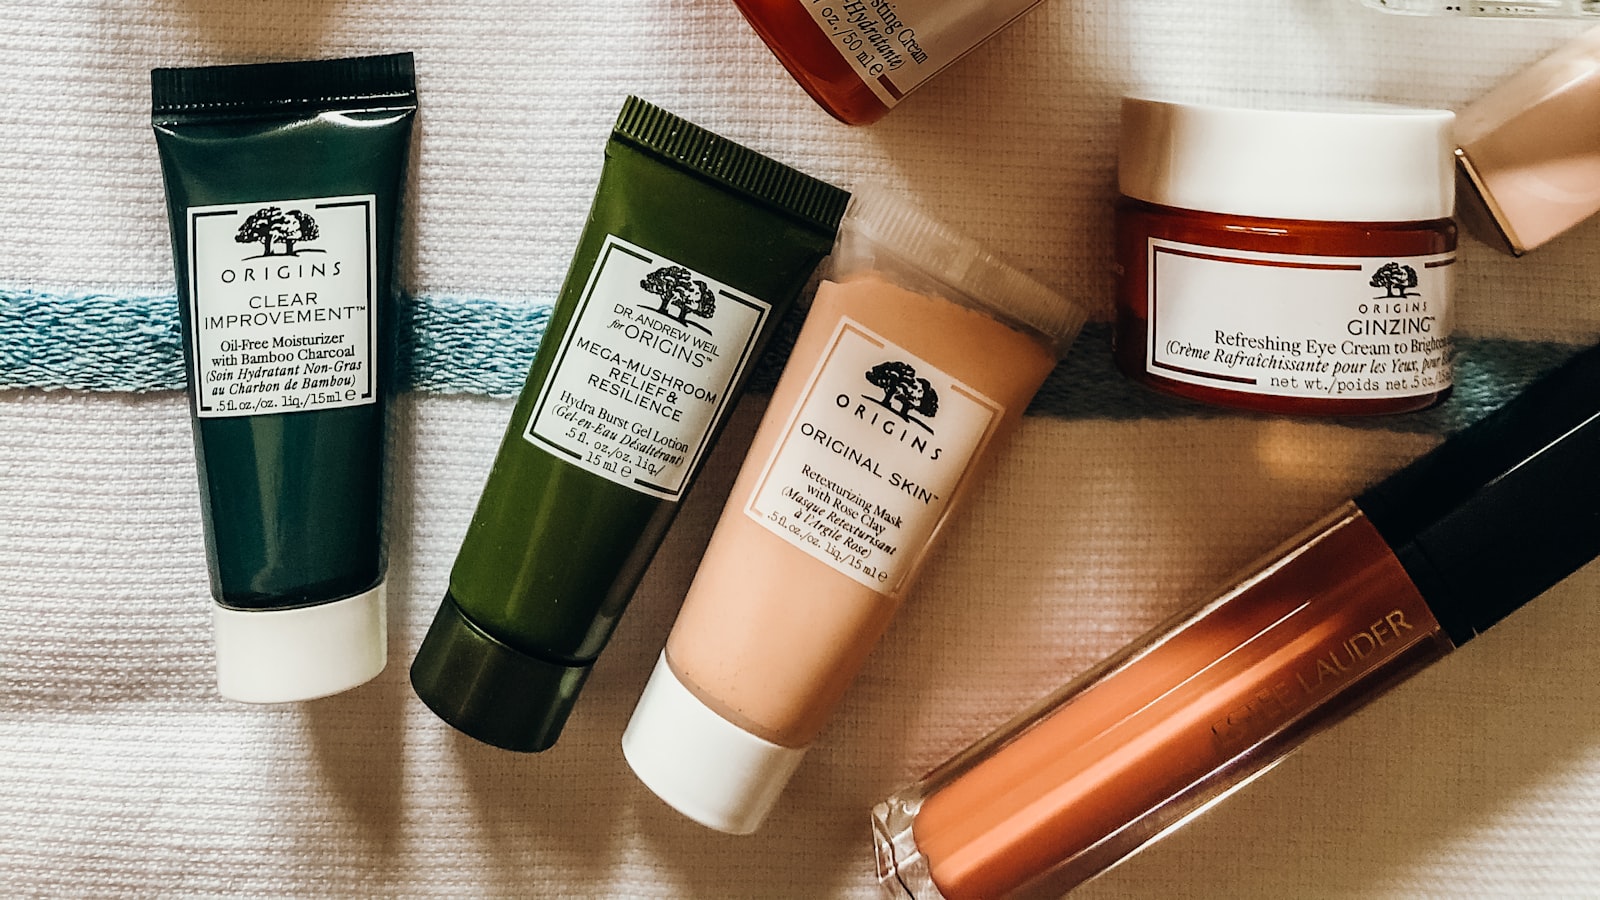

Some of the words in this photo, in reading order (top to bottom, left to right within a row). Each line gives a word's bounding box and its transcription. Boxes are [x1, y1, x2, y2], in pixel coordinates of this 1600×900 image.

[897, 28, 929, 65] Cream
[221, 261, 341, 284] ORIGINS
[249, 292, 318, 309] CLEAR
[1358, 301, 1427, 314] ORIGINS
[220, 339, 269, 352] Oil-Free
[272, 333, 345, 348] Moisturizer
[607, 319, 625, 331] for
[613, 303, 634, 320] DR.
[635, 313, 691, 343] ANDREW
[692, 336, 720, 357] WEIL
[211, 353, 238, 367] with
[241, 351, 294, 365] Bamboo
[297, 345, 355, 361] Charcoal
[1166, 340, 1210, 360] (Crème
[1214, 348, 1330, 373] Rafraîchissante
[1332, 360, 1367, 377] pour
[1370, 359, 1387, 374] les
[1215, 330, 1301, 356] Refreshing
[1306, 339, 1337, 358] Eye
[1341, 340, 1391, 355] Cream
[1394, 342, 1408, 354] to
[206, 370, 233, 384] (Soin
[237, 364, 300, 382] Hydratant
[303, 360, 362, 375] Non-Gras
[211, 385, 225, 396] au
[229, 381, 280, 395] Charbon
[284, 378, 298, 390] de
[301, 374, 356, 390] Bambou)
[576, 337, 718, 405] MEGA-MUSHROOM
[1270, 376, 1299, 389] net
[1386, 379, 1408, 391] net
[588, 374, 683, 422] RESILIENCE
[551, 404, 618, 440] (Gel-en-Eau
[620, 434, 685, 467] Désaltérant)
[560, 390, 595, 415] Hydra
[597, 407, 630, 430] Burst
[631, 422, 652, 439] Gel
[654, 431, 689, 453] Lotion
[836, 394, 942, 461] ORIGINS
[801, 422, 882, 478] ORIGINAL
[801, 464, 873, 514] Retexturizing
[874, 505, 904, 529] Mask
[807, 484, 832, 505] with
[832, 500, 859, 520] Rose
[861, 513, 886, 537] Clay
[781, 485, 826, 516] (Masque
[826, 511, 898, 555] Retexturisant
[843, 537, 872, 559] Rose)
[1296, 609, 1413, 694] LAUDER
